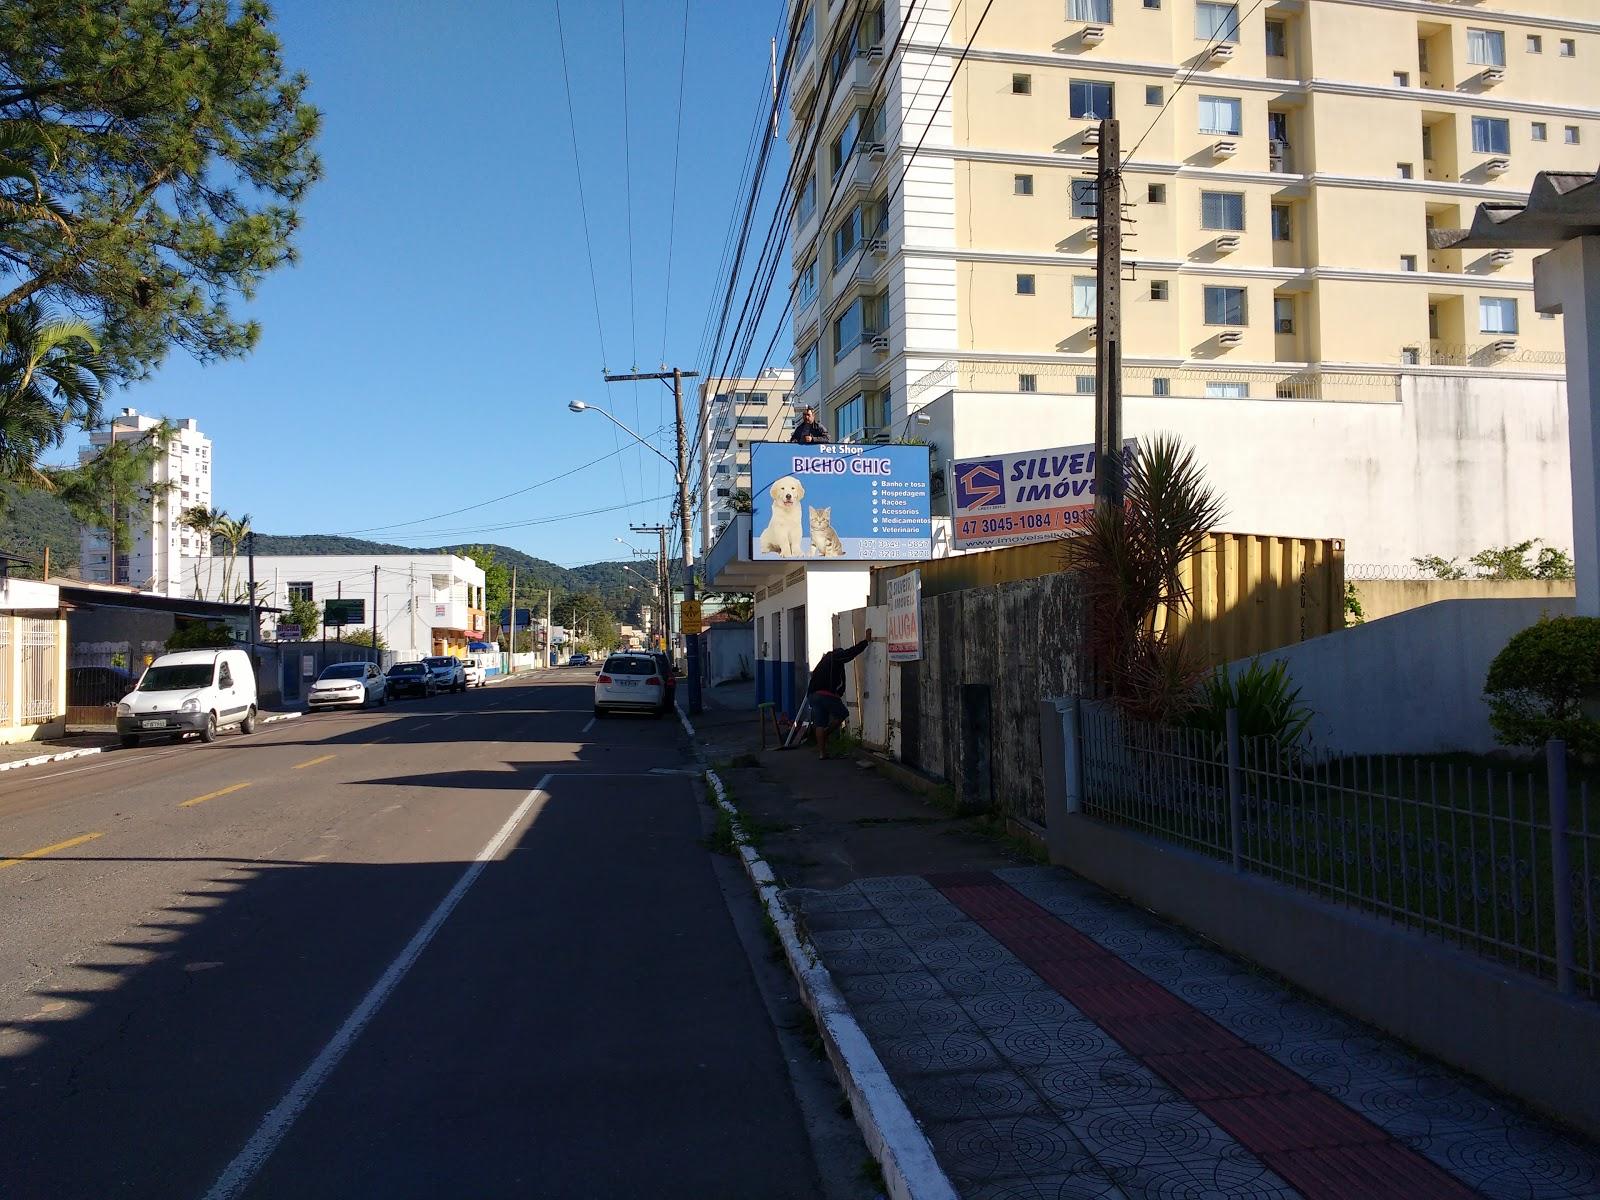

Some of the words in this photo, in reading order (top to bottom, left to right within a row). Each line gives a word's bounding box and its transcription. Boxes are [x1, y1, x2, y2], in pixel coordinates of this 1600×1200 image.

[820, 445, 836, 454] Pet
[839, 445, 863, 456] Shop
[794, 458, 846, 474] BICHO
[851, 459, 891, 475] CHIC
[1010, 446, 1132, 482] SILVEI
[962, 520, 977, 535] 47
[982, 512, 1050, 533] 3045-1084
